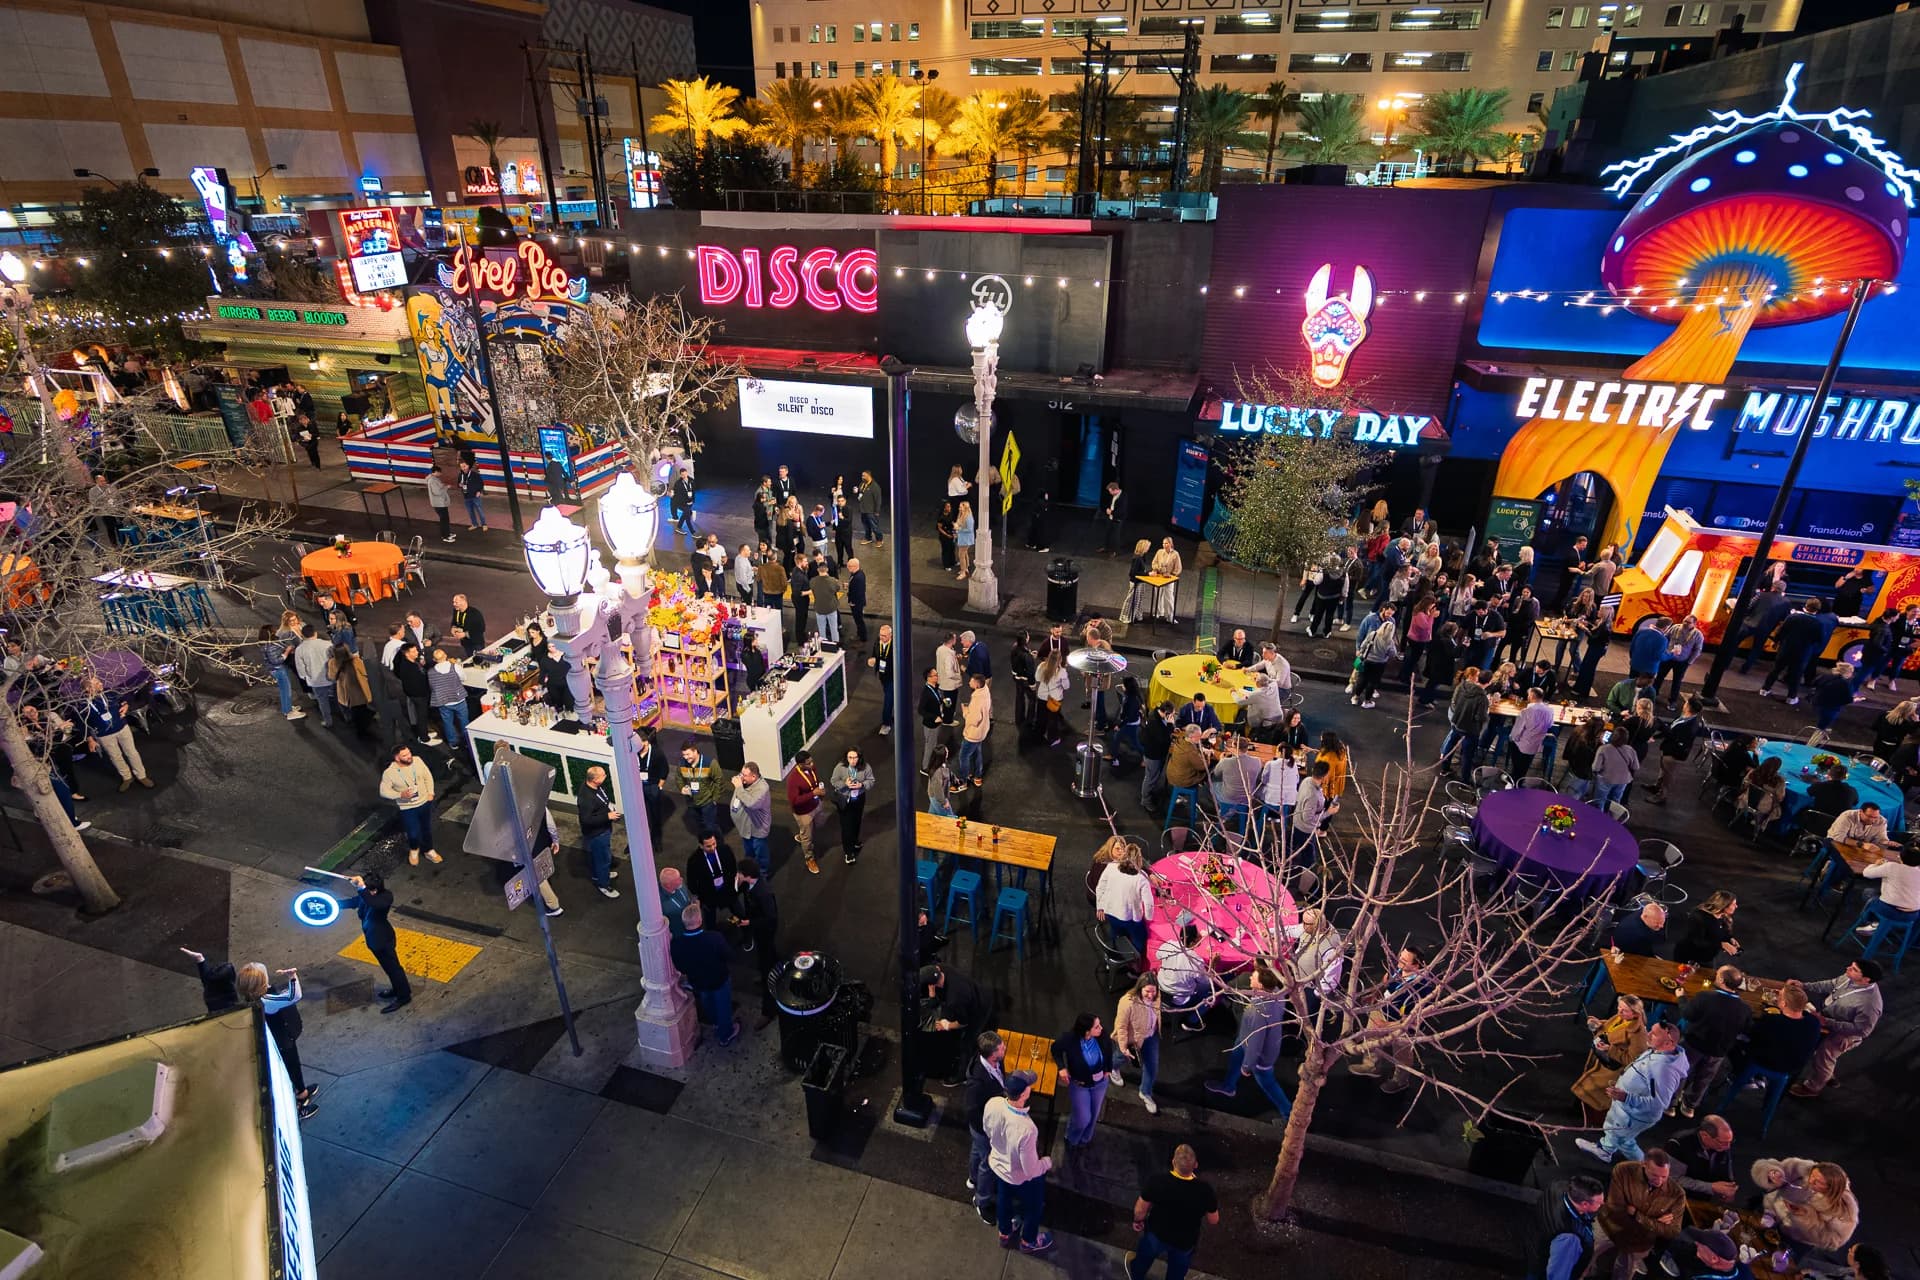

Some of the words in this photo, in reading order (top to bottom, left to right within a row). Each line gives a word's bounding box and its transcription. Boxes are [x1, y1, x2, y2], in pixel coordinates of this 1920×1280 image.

[381, 254, 396, 262] HOUR
[452, 245, 516, 297] Evel
[518, 240, 570, 299] Pie
[697, 245, 878, 312] DISCO
[219, 306, 260, 320] BURGERS
[267, 309, 298, 322] BEERS
[304, 311, 346, 326] BLOODYS
[789, 396, 809, 404] DISCO
[777, 403, 804, 413] SILENT
[811, 406, 834, 416] DISCO
[1220, 402, 1342, 438] LUCKY
[1354, 412, 1430, 445] DAY
[1496, 507, 1520, 516] LUCKY
[1809, 524, 1863, 537] TransUnion
[1797, 543, 1850, 557] EMPANADAS
[1796, 552, 1831, 562] STREET
[1831, 554, 1856, 564] CORN
